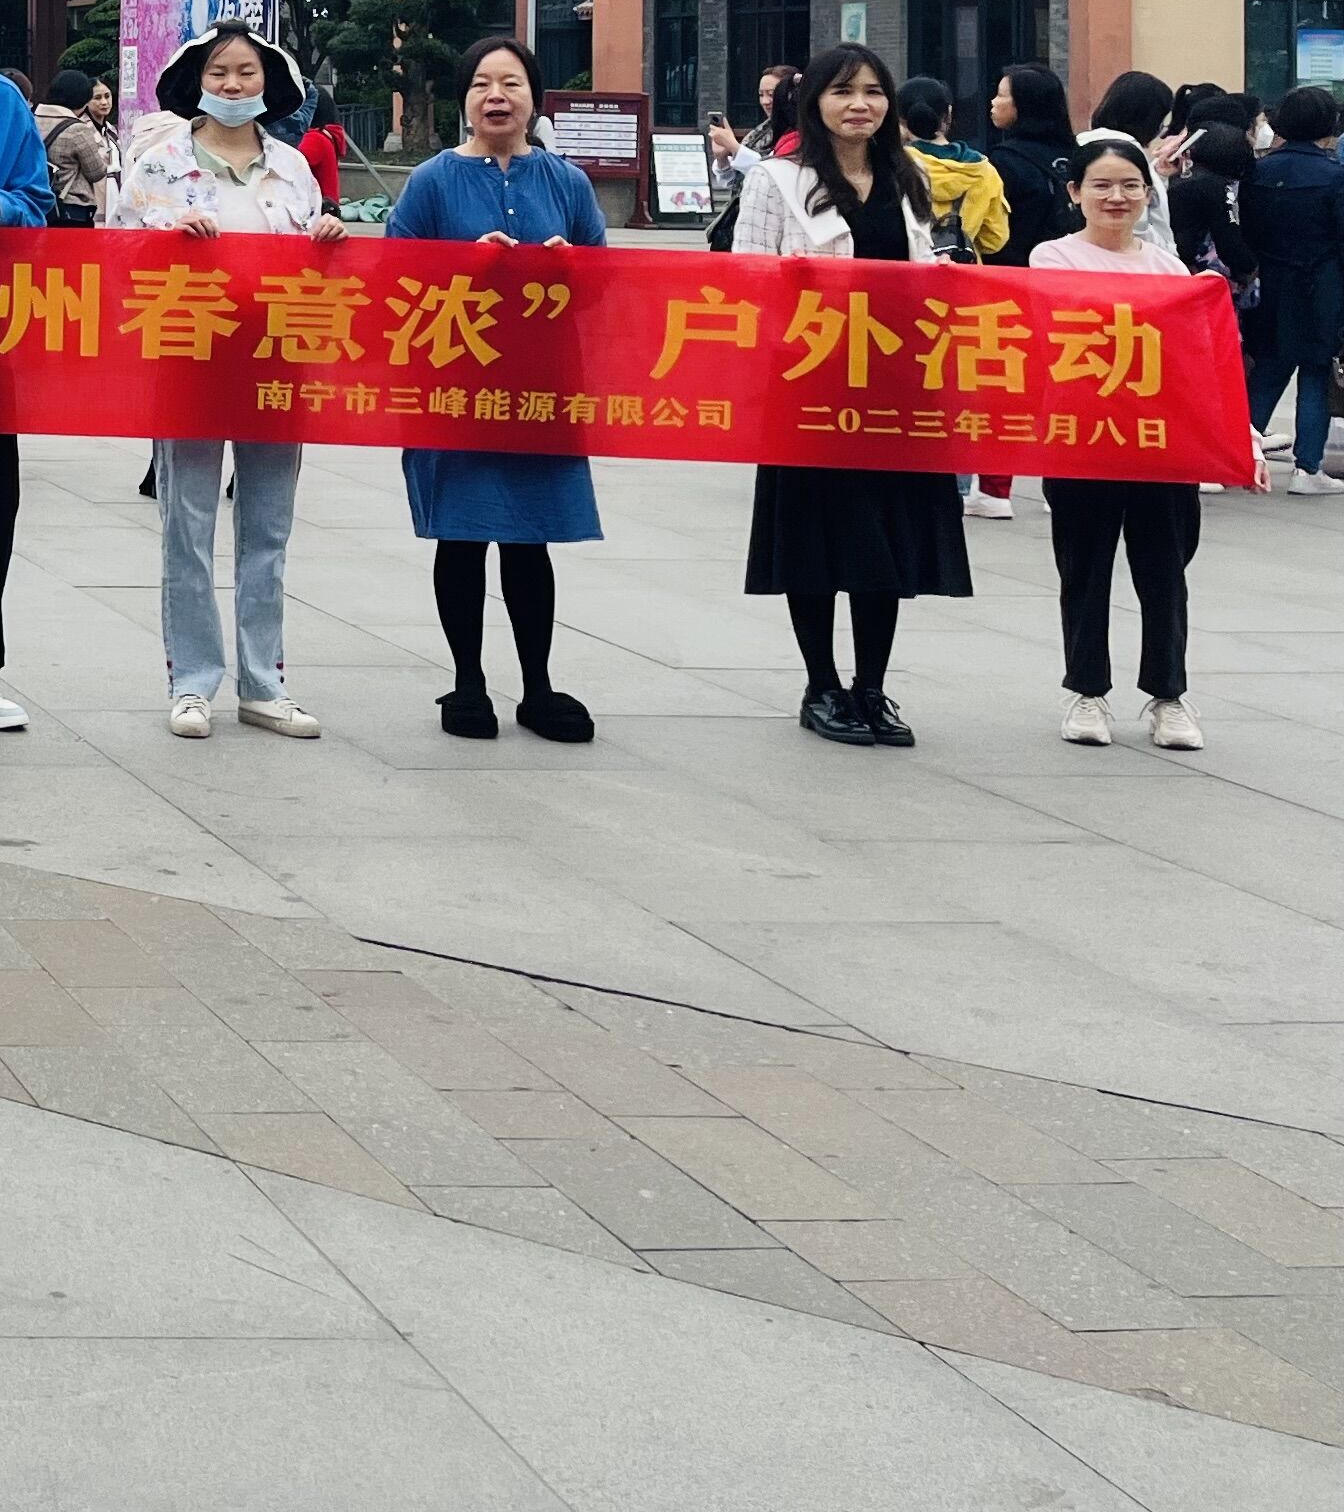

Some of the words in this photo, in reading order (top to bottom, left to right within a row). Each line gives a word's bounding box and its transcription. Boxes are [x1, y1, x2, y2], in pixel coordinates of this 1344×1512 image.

[650, 286, 1163, 399] 户外活动
[256, 379, 733, 430] 南宁市三峰能源有限公司
